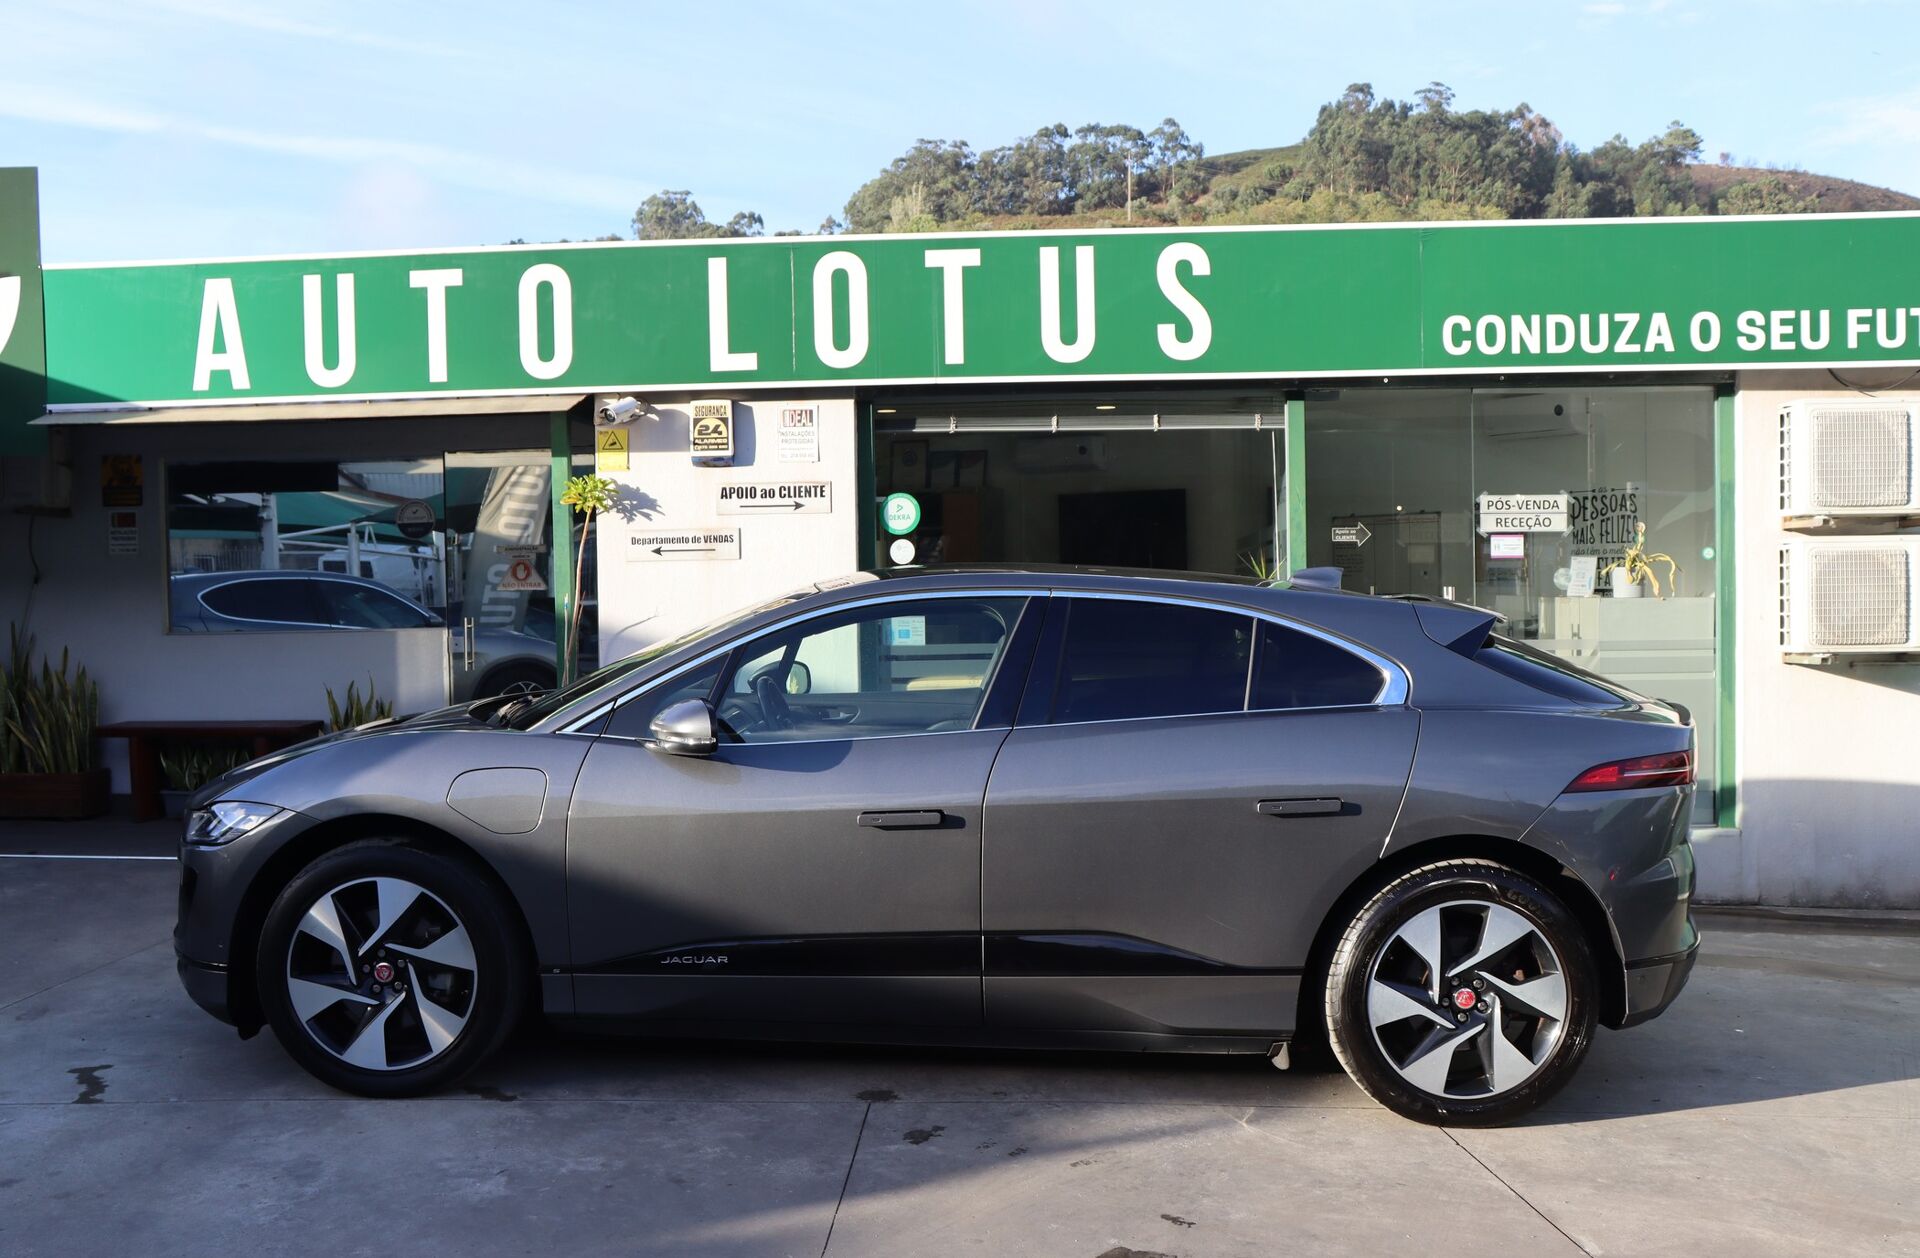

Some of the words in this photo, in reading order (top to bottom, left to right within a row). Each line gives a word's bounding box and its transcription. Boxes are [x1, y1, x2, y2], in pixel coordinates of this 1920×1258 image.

[193, 263, 573, 392] AUTO
[708, 241, 1212, 372] LOTUS
[1442, 312, 1676, 356] CONDUZA
[1689, 311, 1721, 353] O
[1737, 309, 1831, 351] SEU
[783, 409, 813, 427] IDEAL
[697, 423, 723, 436] 24
[720, 485, 758, 500] APOIO
[760, 487, 776, 499] ao
[779, 484, 826, 499] CLIENTE
[1486, 496, 1560, 511] PÓS-VENDA
[1570, 493, 1638, 527] PESSOAS
[889, 513, 911, 521] DEKRA
[1495, 514, 1552, 530] RECEÇÃO
[631, 535, 689, 546] Departamento
[691, 534, 702, 544] de
[703, 533, 734, 544] VENDAS
[1572, 522, 1596, 545] MAIS
[660, 956, 729, 964] JAGUAR
